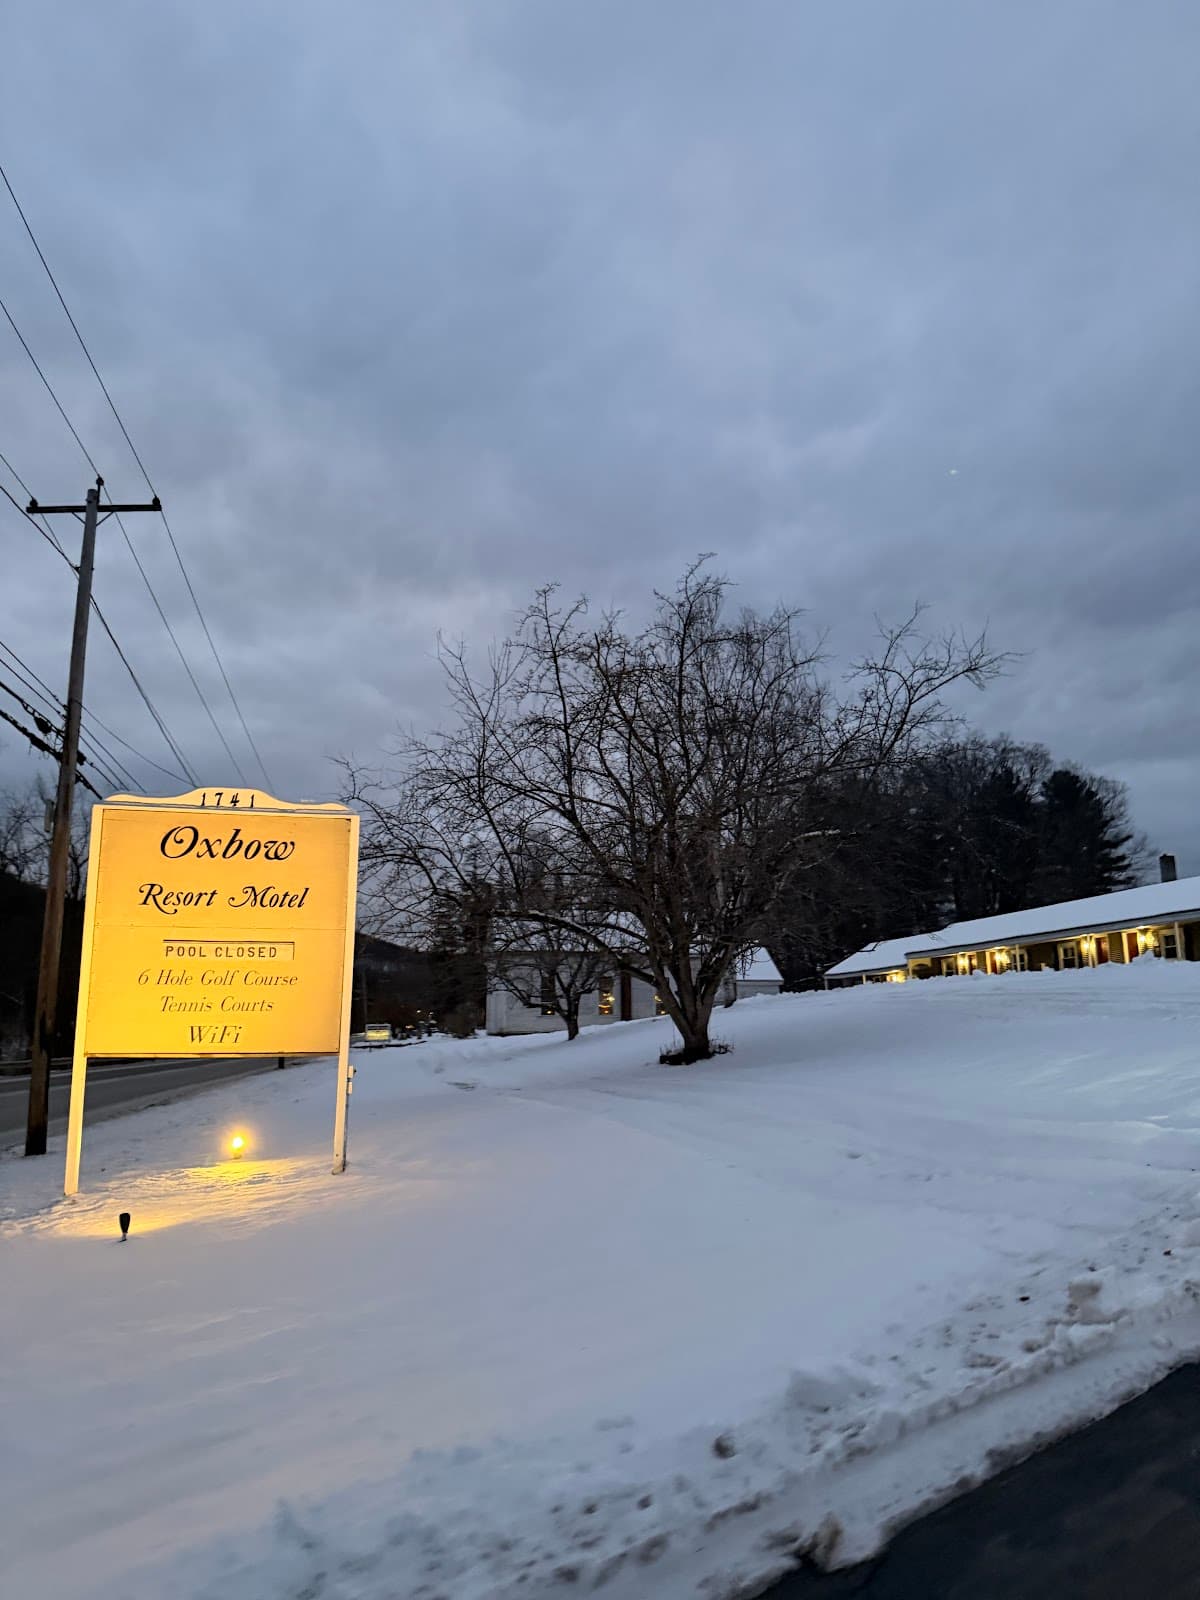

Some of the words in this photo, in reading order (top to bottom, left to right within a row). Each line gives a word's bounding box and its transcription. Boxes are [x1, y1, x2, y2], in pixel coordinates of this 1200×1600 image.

[200, 792, 255, 808] 1741
[160, 825, 295, 861] Oxbow
[138, 883, 218, 914] Resort
[228, 886, 310, 908] Motel
[165, 945, 207, 958] POOL
[215, 946, 278, 959] CLOSED
[138, 969, 149, 985] 6
[156, 969, 193, 986] Hole
[200, 970, 239, 986] Golf
[243, 970, 299, 987] Course
[160, 995, 213, 1012] Tennis
[220, 996, 275, 1012] Courts
[189, 1025, 242, 1044] WiFi
